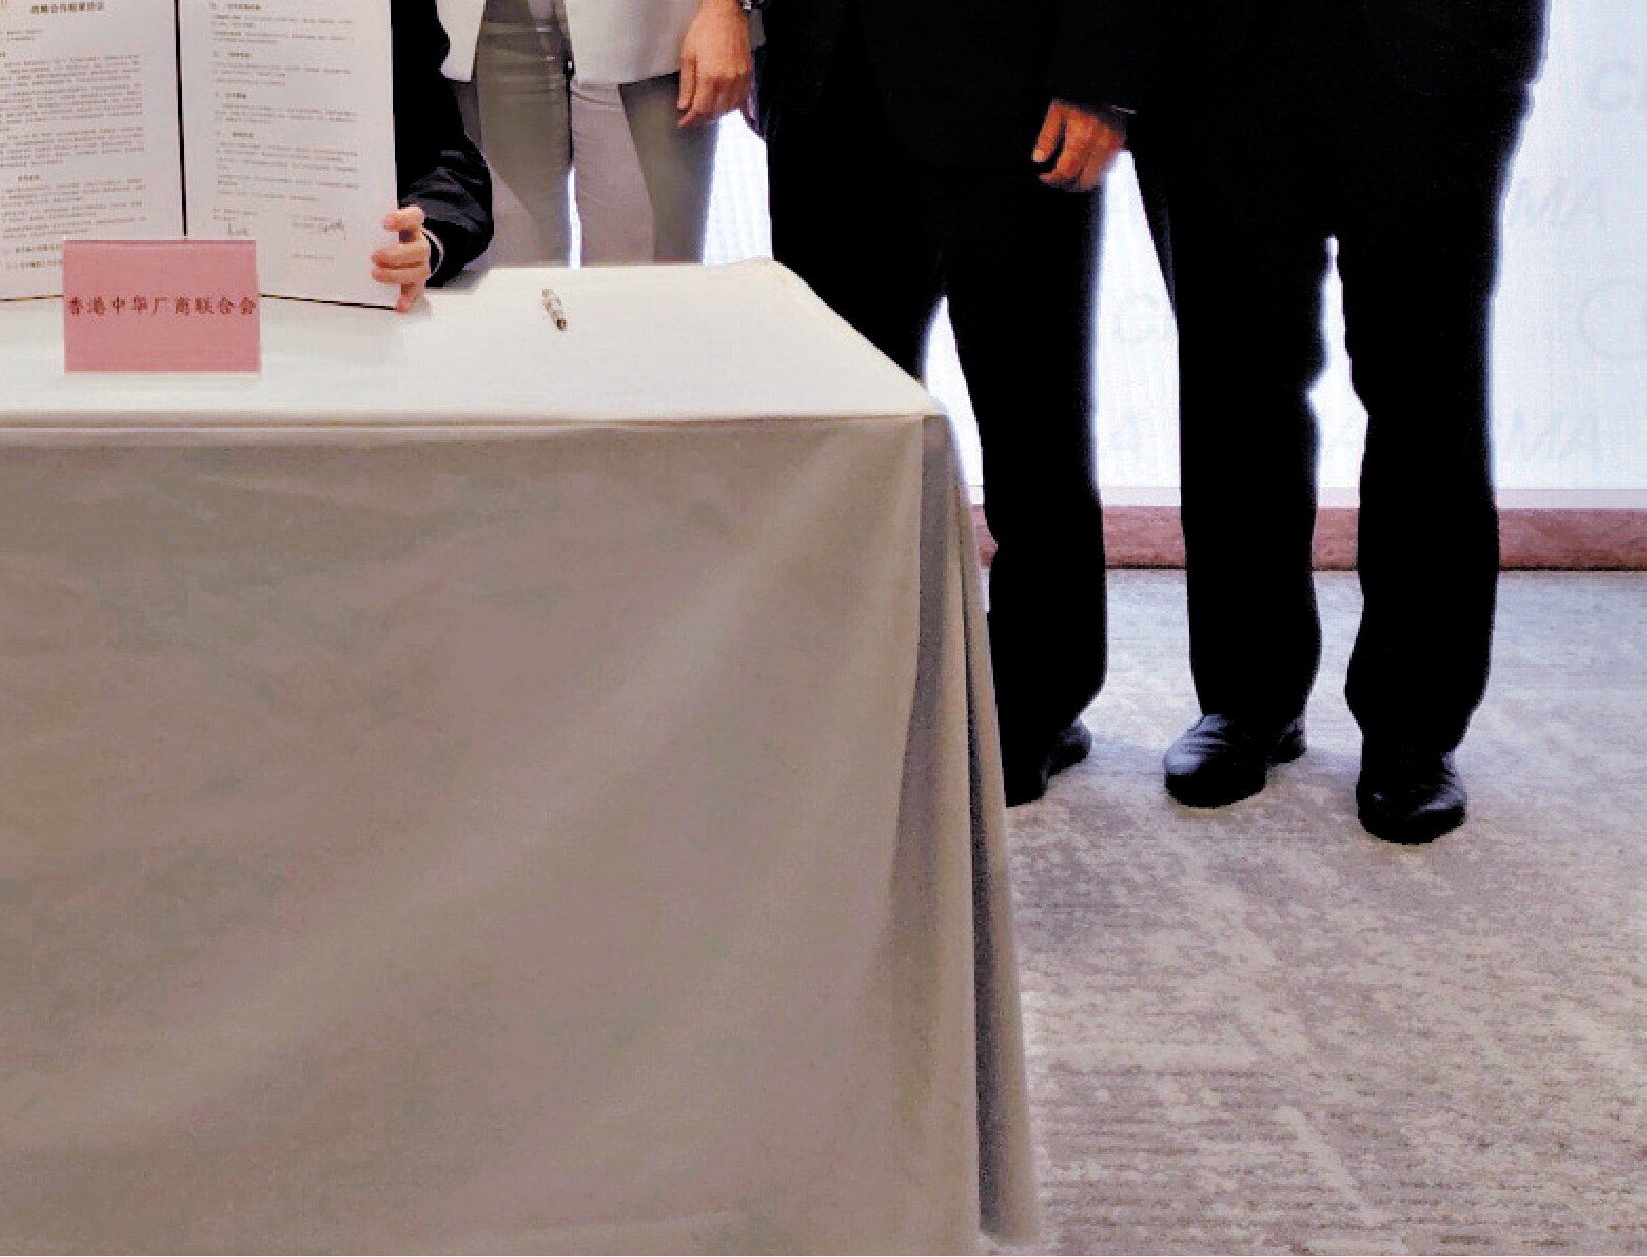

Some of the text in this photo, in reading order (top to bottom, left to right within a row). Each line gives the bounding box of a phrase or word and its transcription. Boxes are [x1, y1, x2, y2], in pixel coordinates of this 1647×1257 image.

[1510, 178, 1605, 227] MA
[67, 295, 257, 317] 香港中华厂商联合会
